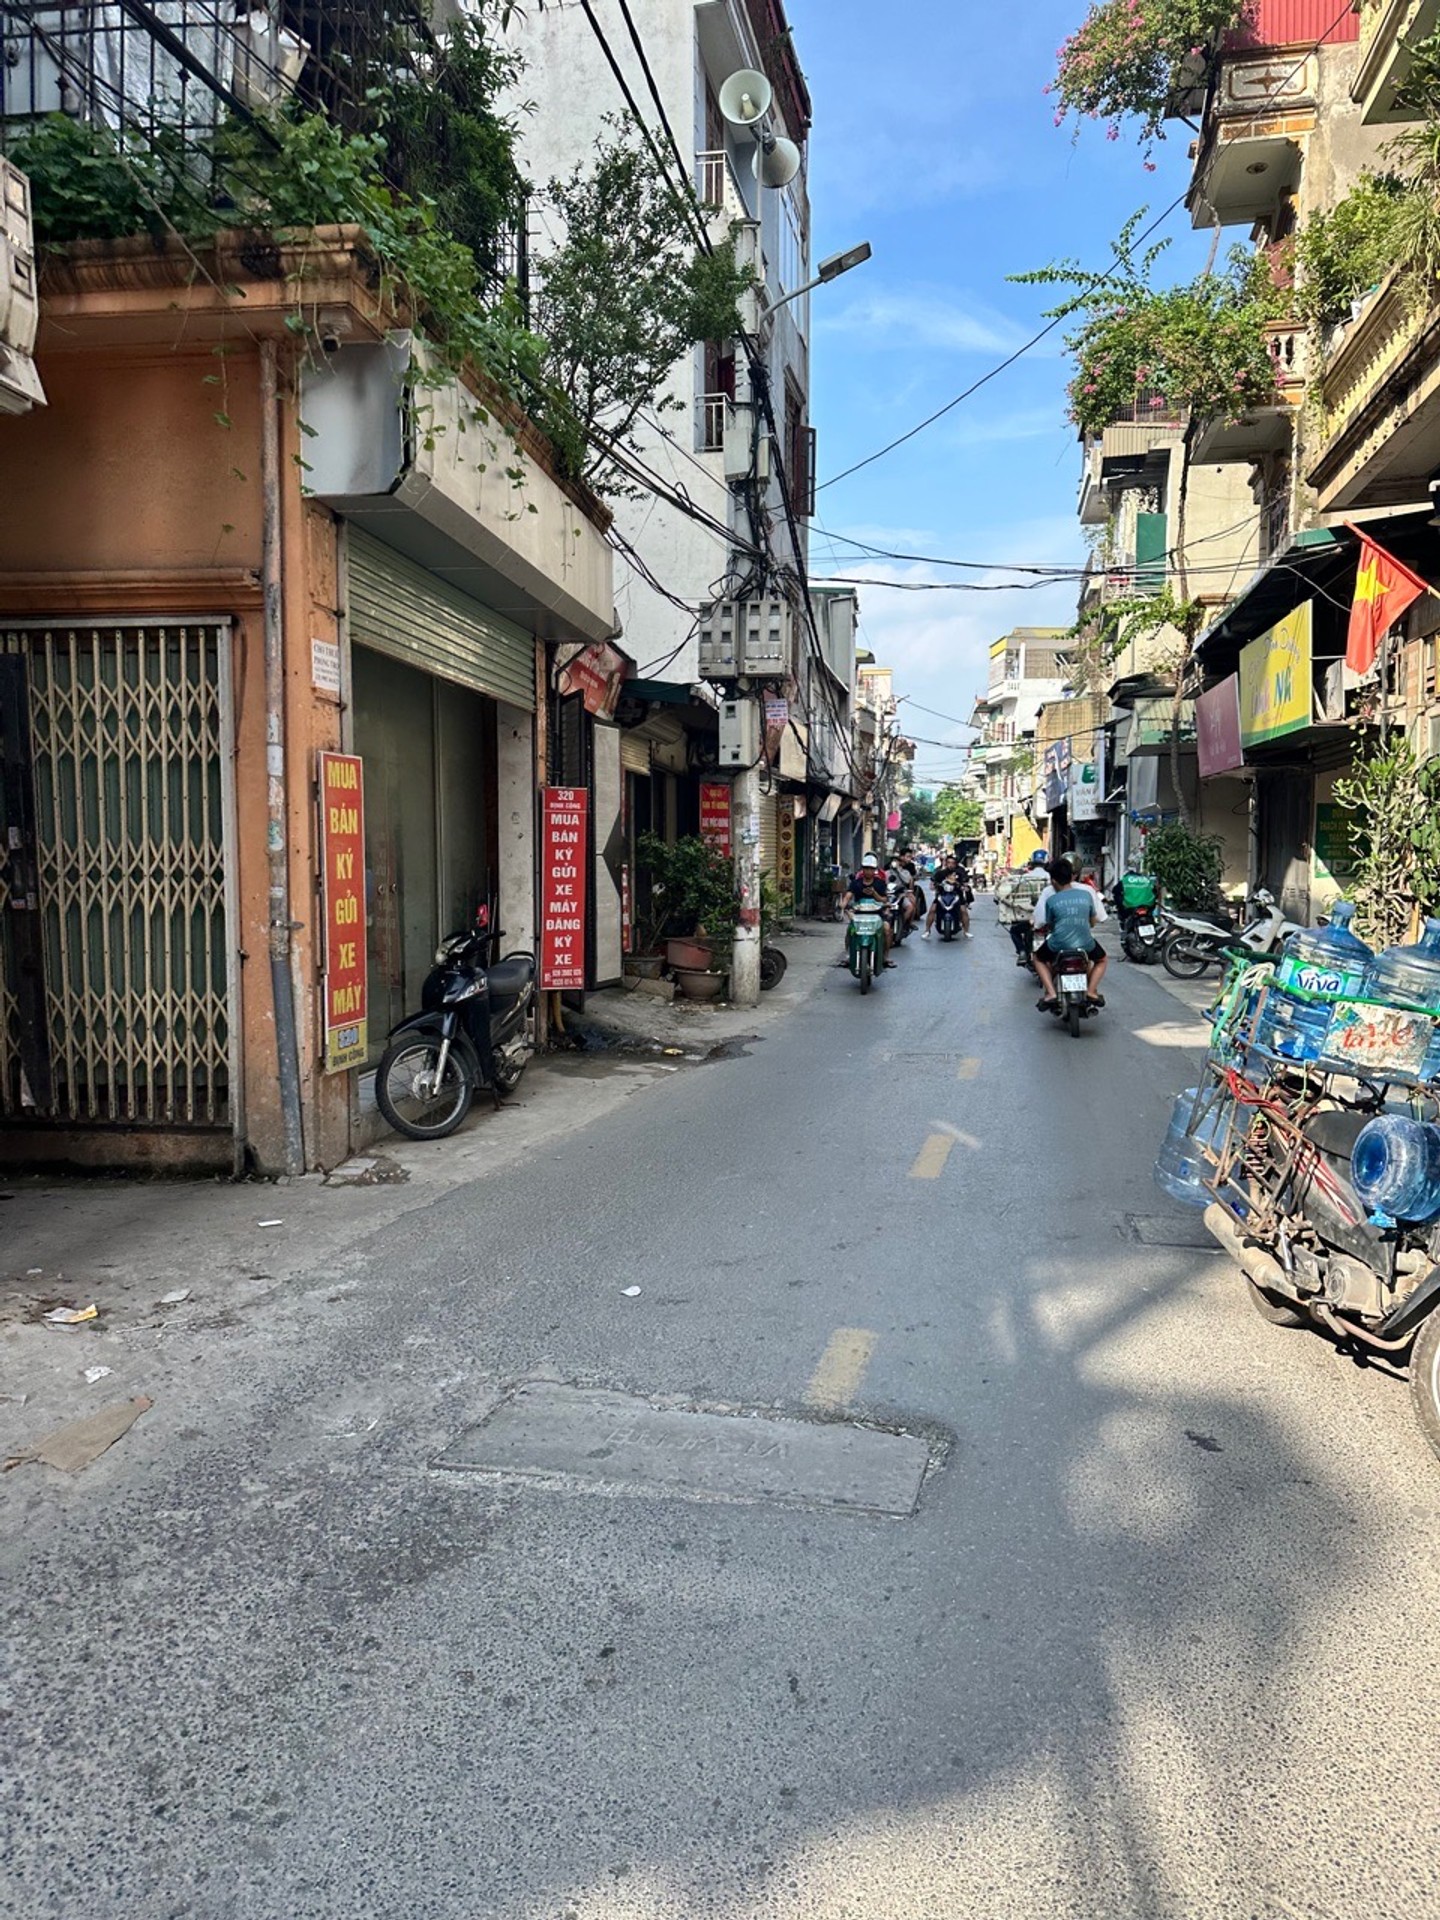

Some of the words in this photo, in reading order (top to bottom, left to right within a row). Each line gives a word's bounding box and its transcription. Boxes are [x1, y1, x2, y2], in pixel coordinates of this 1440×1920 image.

[326, 760, 358, 789] MUA
[557, 790, 574, 801] 320
[329, 802, 358, 834] BÁN
[550, 813, 580, 826] MUA
[551, 829, 578, 843] BÁN
[554, 846, 573, 861] KÝ
[335, 847, 354, 880] KÝ
[552, 862, 577, 878] GỬI
[555, 883, 573, 896] XE
[335, 889, 358, 925] GỬI
[549, 899, 578, 914] MÁY
[545, 917, 581, 930] ĐĂNG
[554, 934, 573, 948] KÝ
[339, 942, 356, 970] XE
[554, 953, 573, 966] XE
[1297, 972, 1342, 992] Viva
[333, 981, 362, 1016] MÁY
